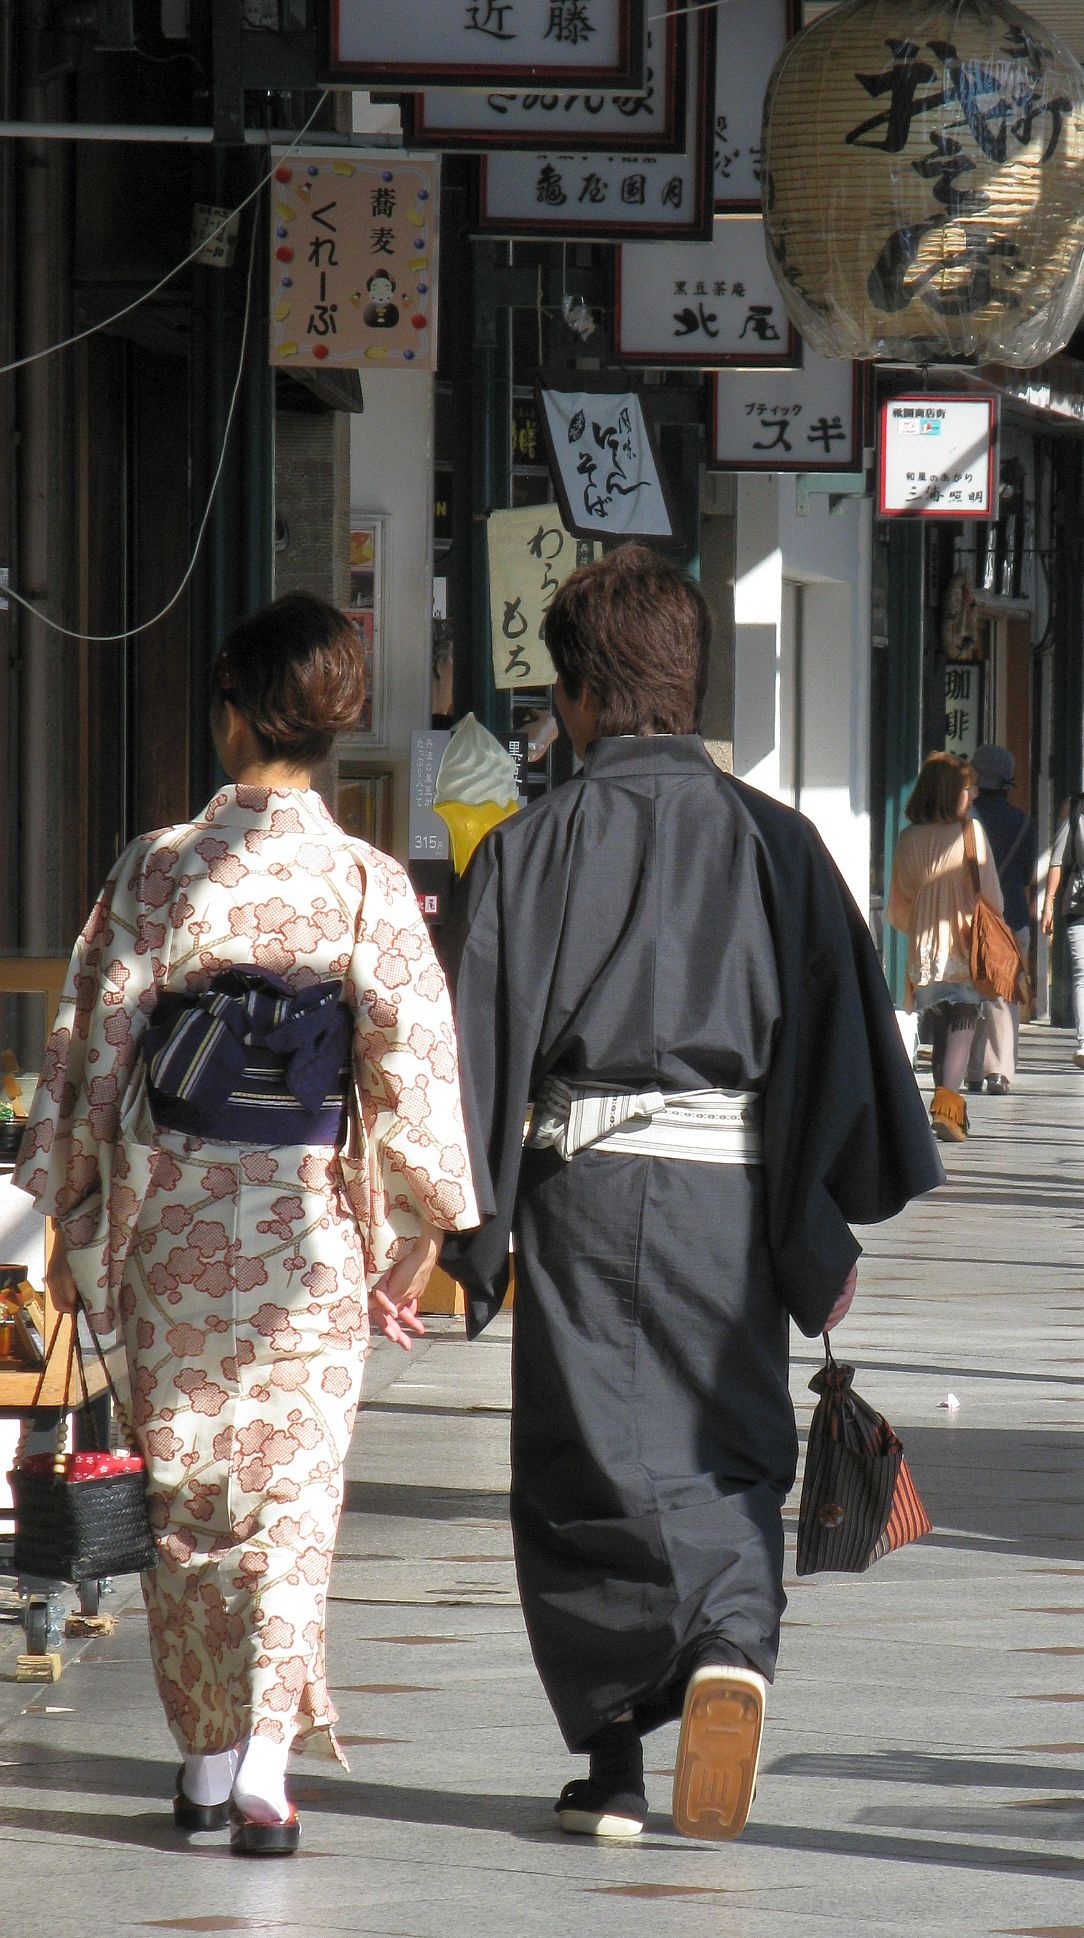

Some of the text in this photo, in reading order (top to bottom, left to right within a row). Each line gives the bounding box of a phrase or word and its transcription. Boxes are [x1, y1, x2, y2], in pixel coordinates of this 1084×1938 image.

[463, 0, 597, 45] 近藤
[369, 187, 397, 255] 蕎麦
[306, 201, 339, 336] くれーぷ
[672, 280, 747, 297] 黒豆茶庵
[672, 302, 781, 341] 北尾
[745, 402, 803, 417] ブティック
[752, 415, 847, 454] スギ
[502, 596, 532, 678] もち
[945, 669, 971, 760] 珈琲
